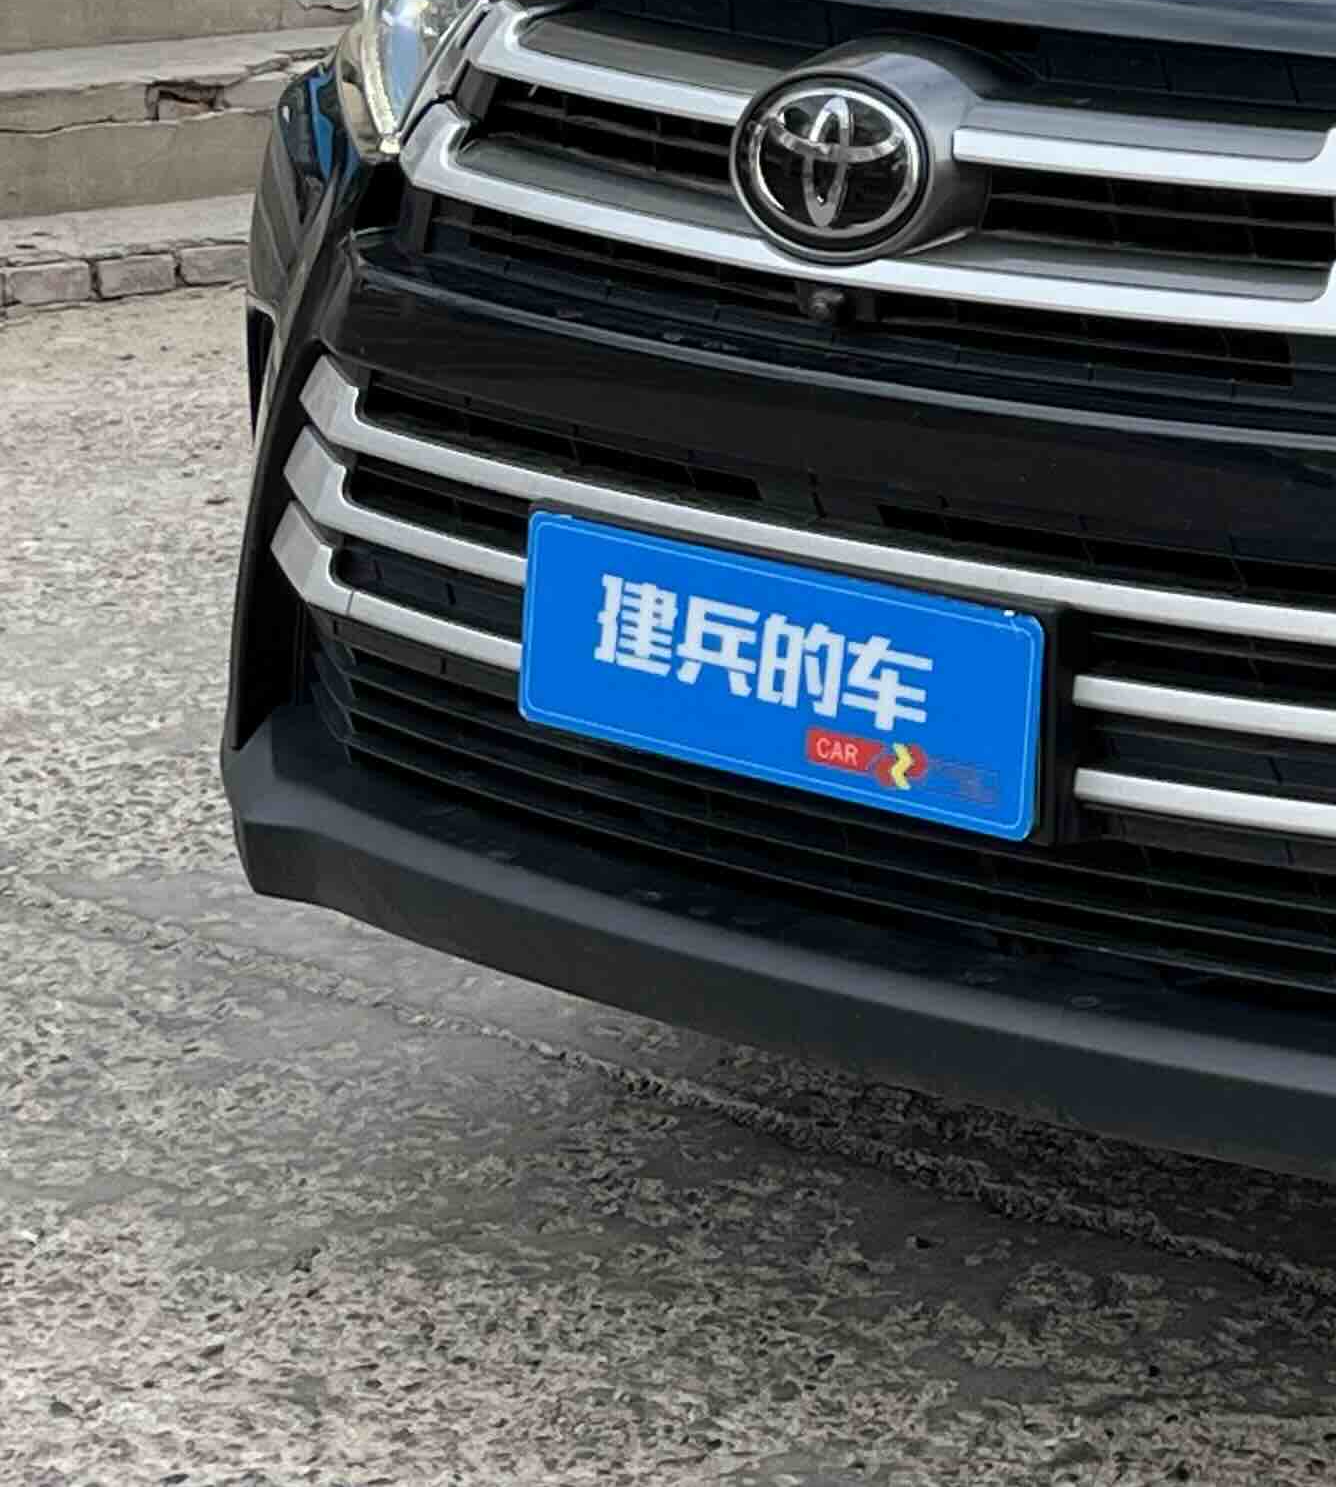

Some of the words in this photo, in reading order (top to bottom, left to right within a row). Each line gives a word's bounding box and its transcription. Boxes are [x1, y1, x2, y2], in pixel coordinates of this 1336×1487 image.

[594, 573, 934, 731] 建兵的车
[815, 736, 859, 766] CAR
